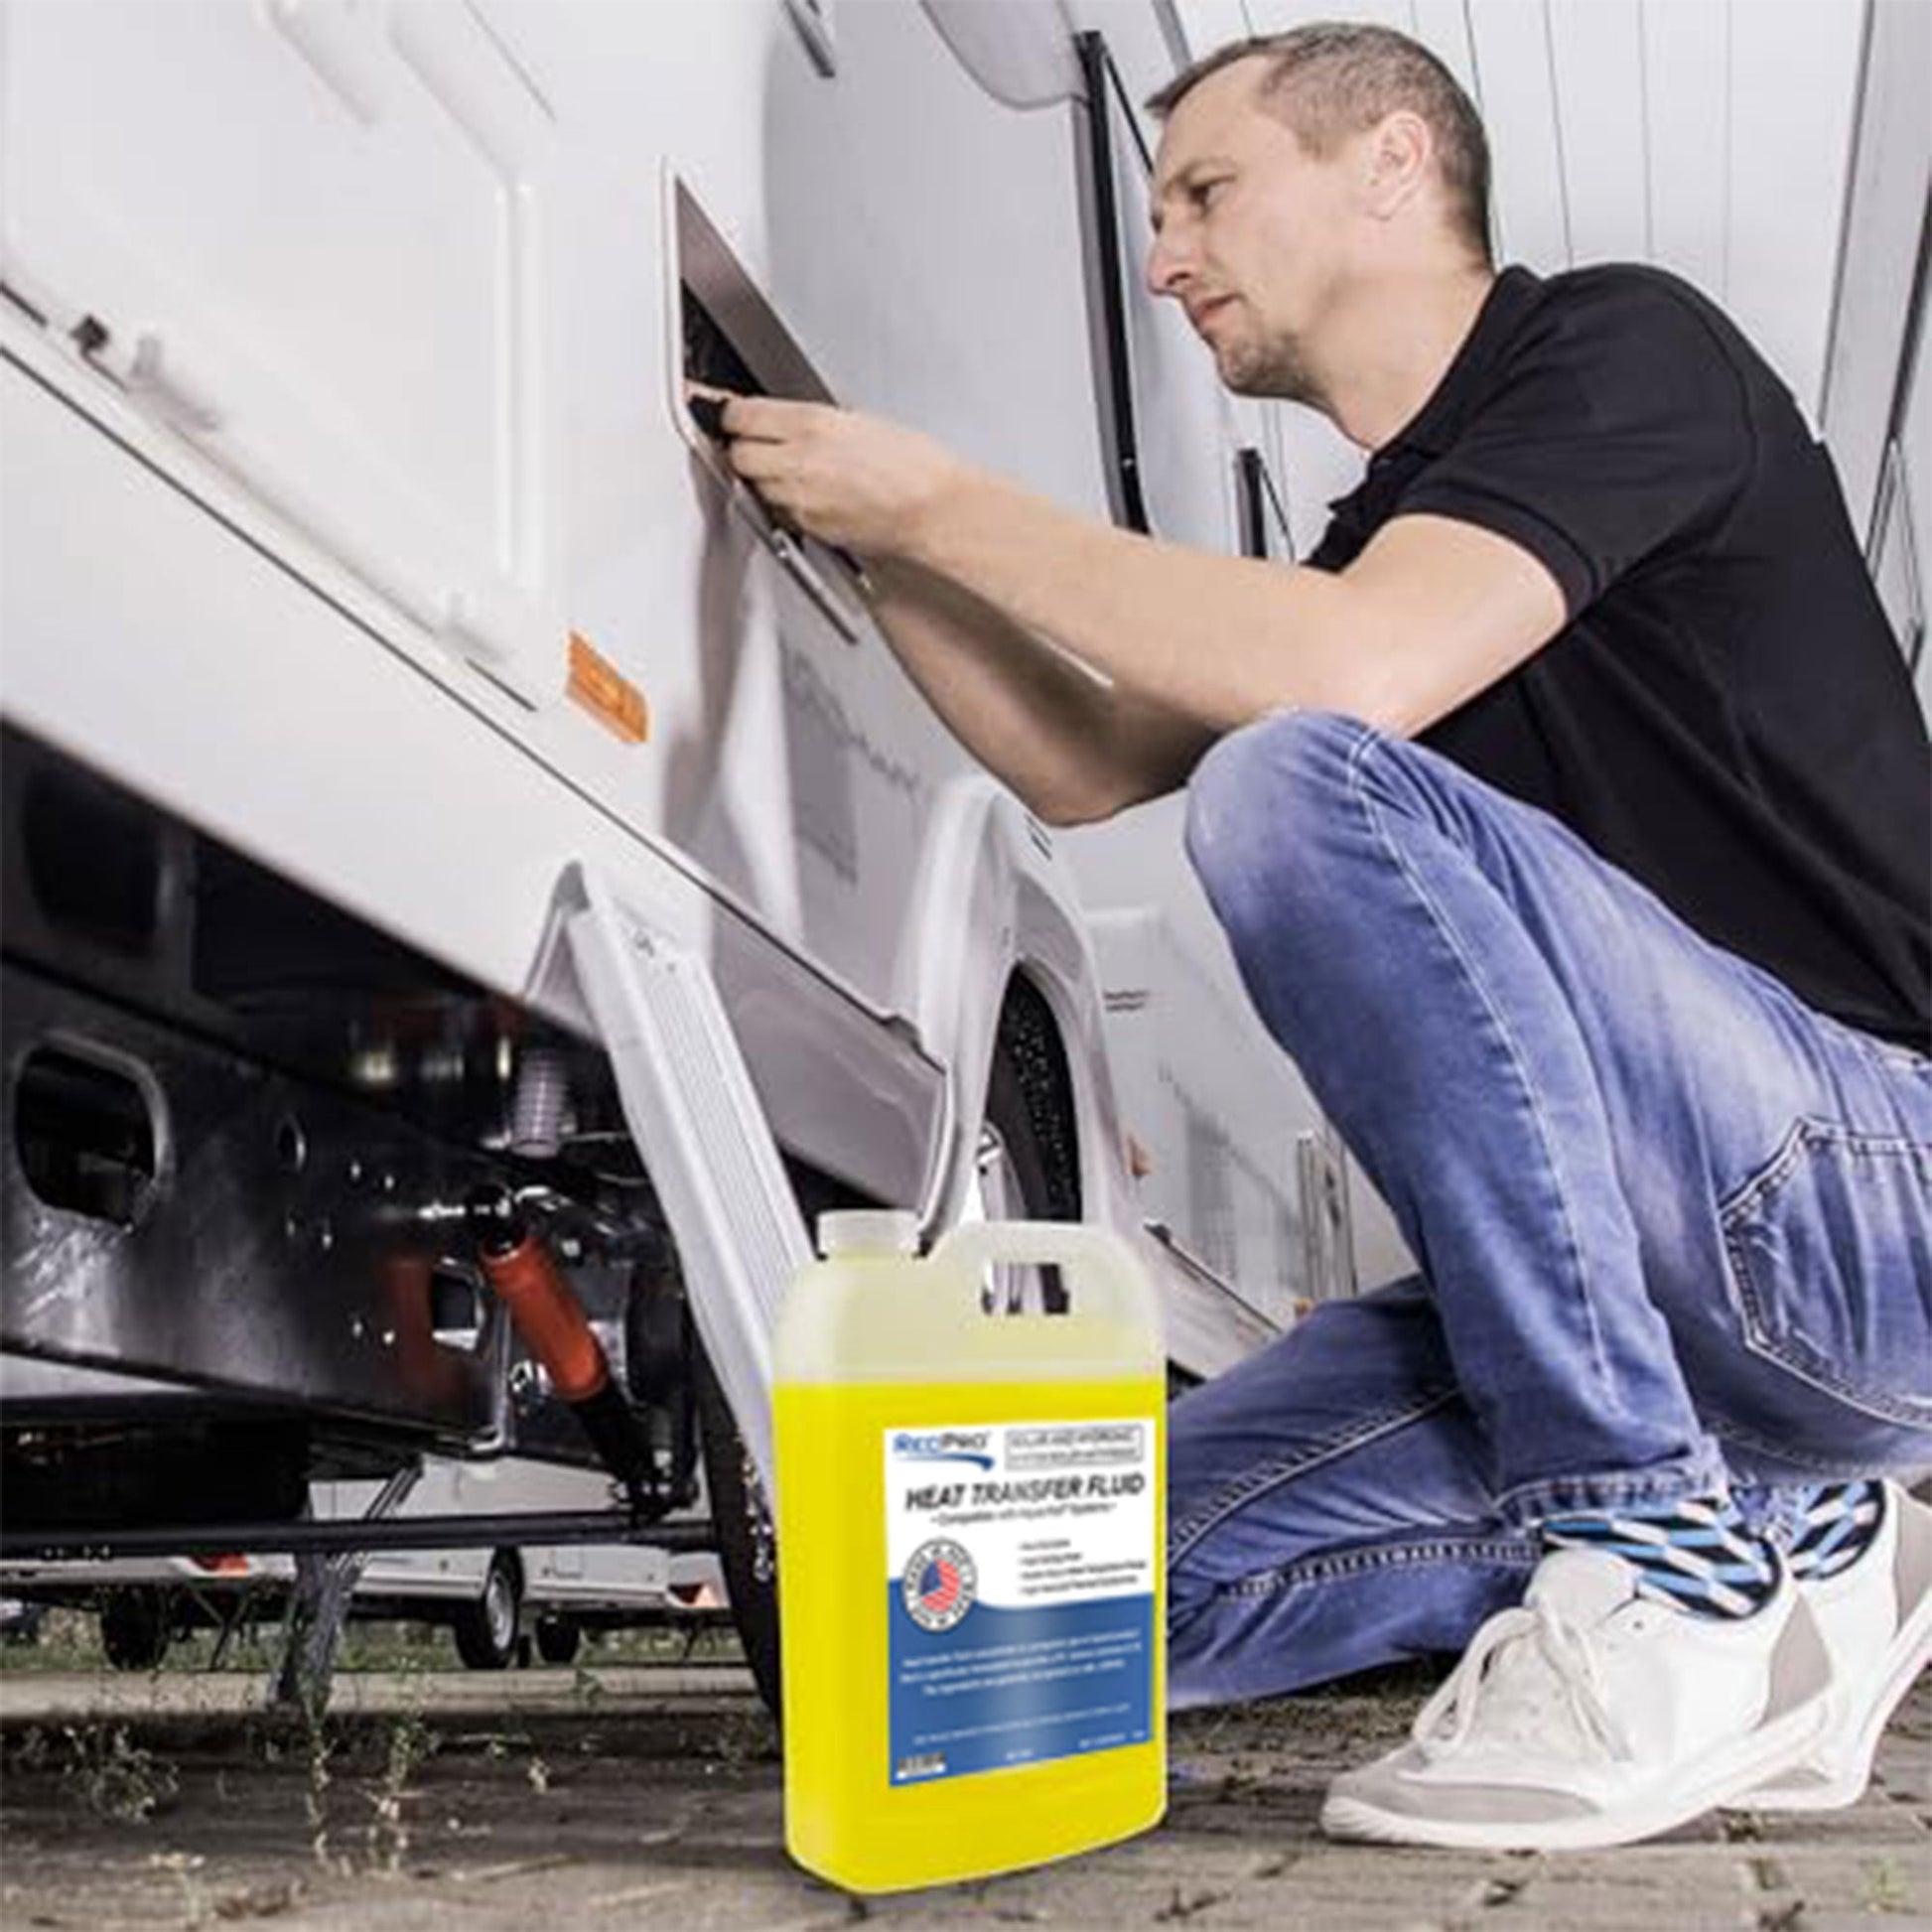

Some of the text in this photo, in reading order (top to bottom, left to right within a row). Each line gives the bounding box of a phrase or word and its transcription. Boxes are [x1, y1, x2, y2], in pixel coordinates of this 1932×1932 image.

[905, 1470, 1146, 1511] HEAT TRANSFER FLUID
